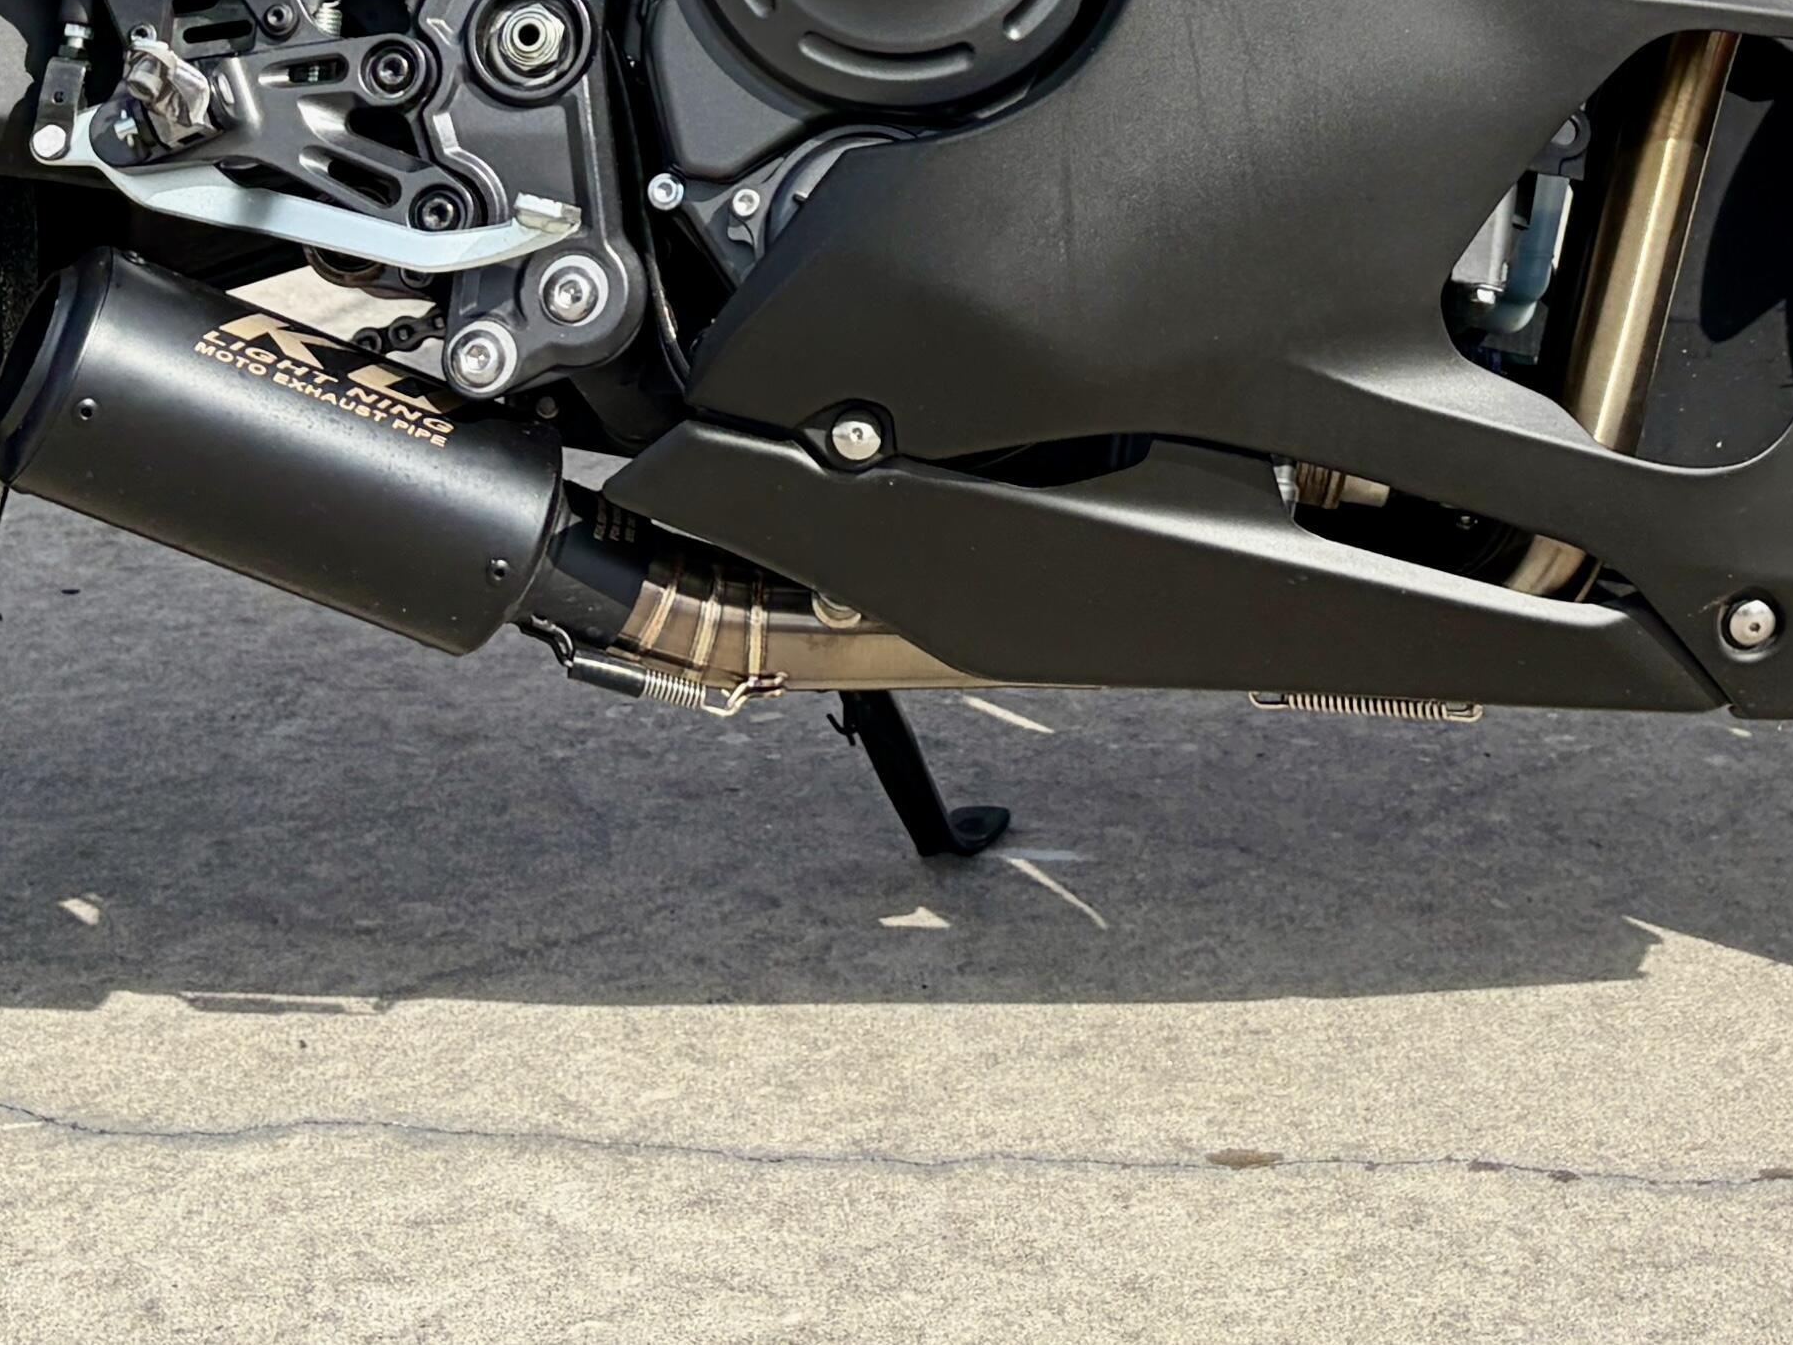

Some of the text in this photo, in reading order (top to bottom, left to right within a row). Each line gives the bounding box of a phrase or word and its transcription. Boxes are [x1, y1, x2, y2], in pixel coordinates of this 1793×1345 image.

[194, 341, 448, 448] MOTO EXHAUST PIPE
[203, 330, 455, 434] LIGHT NING
